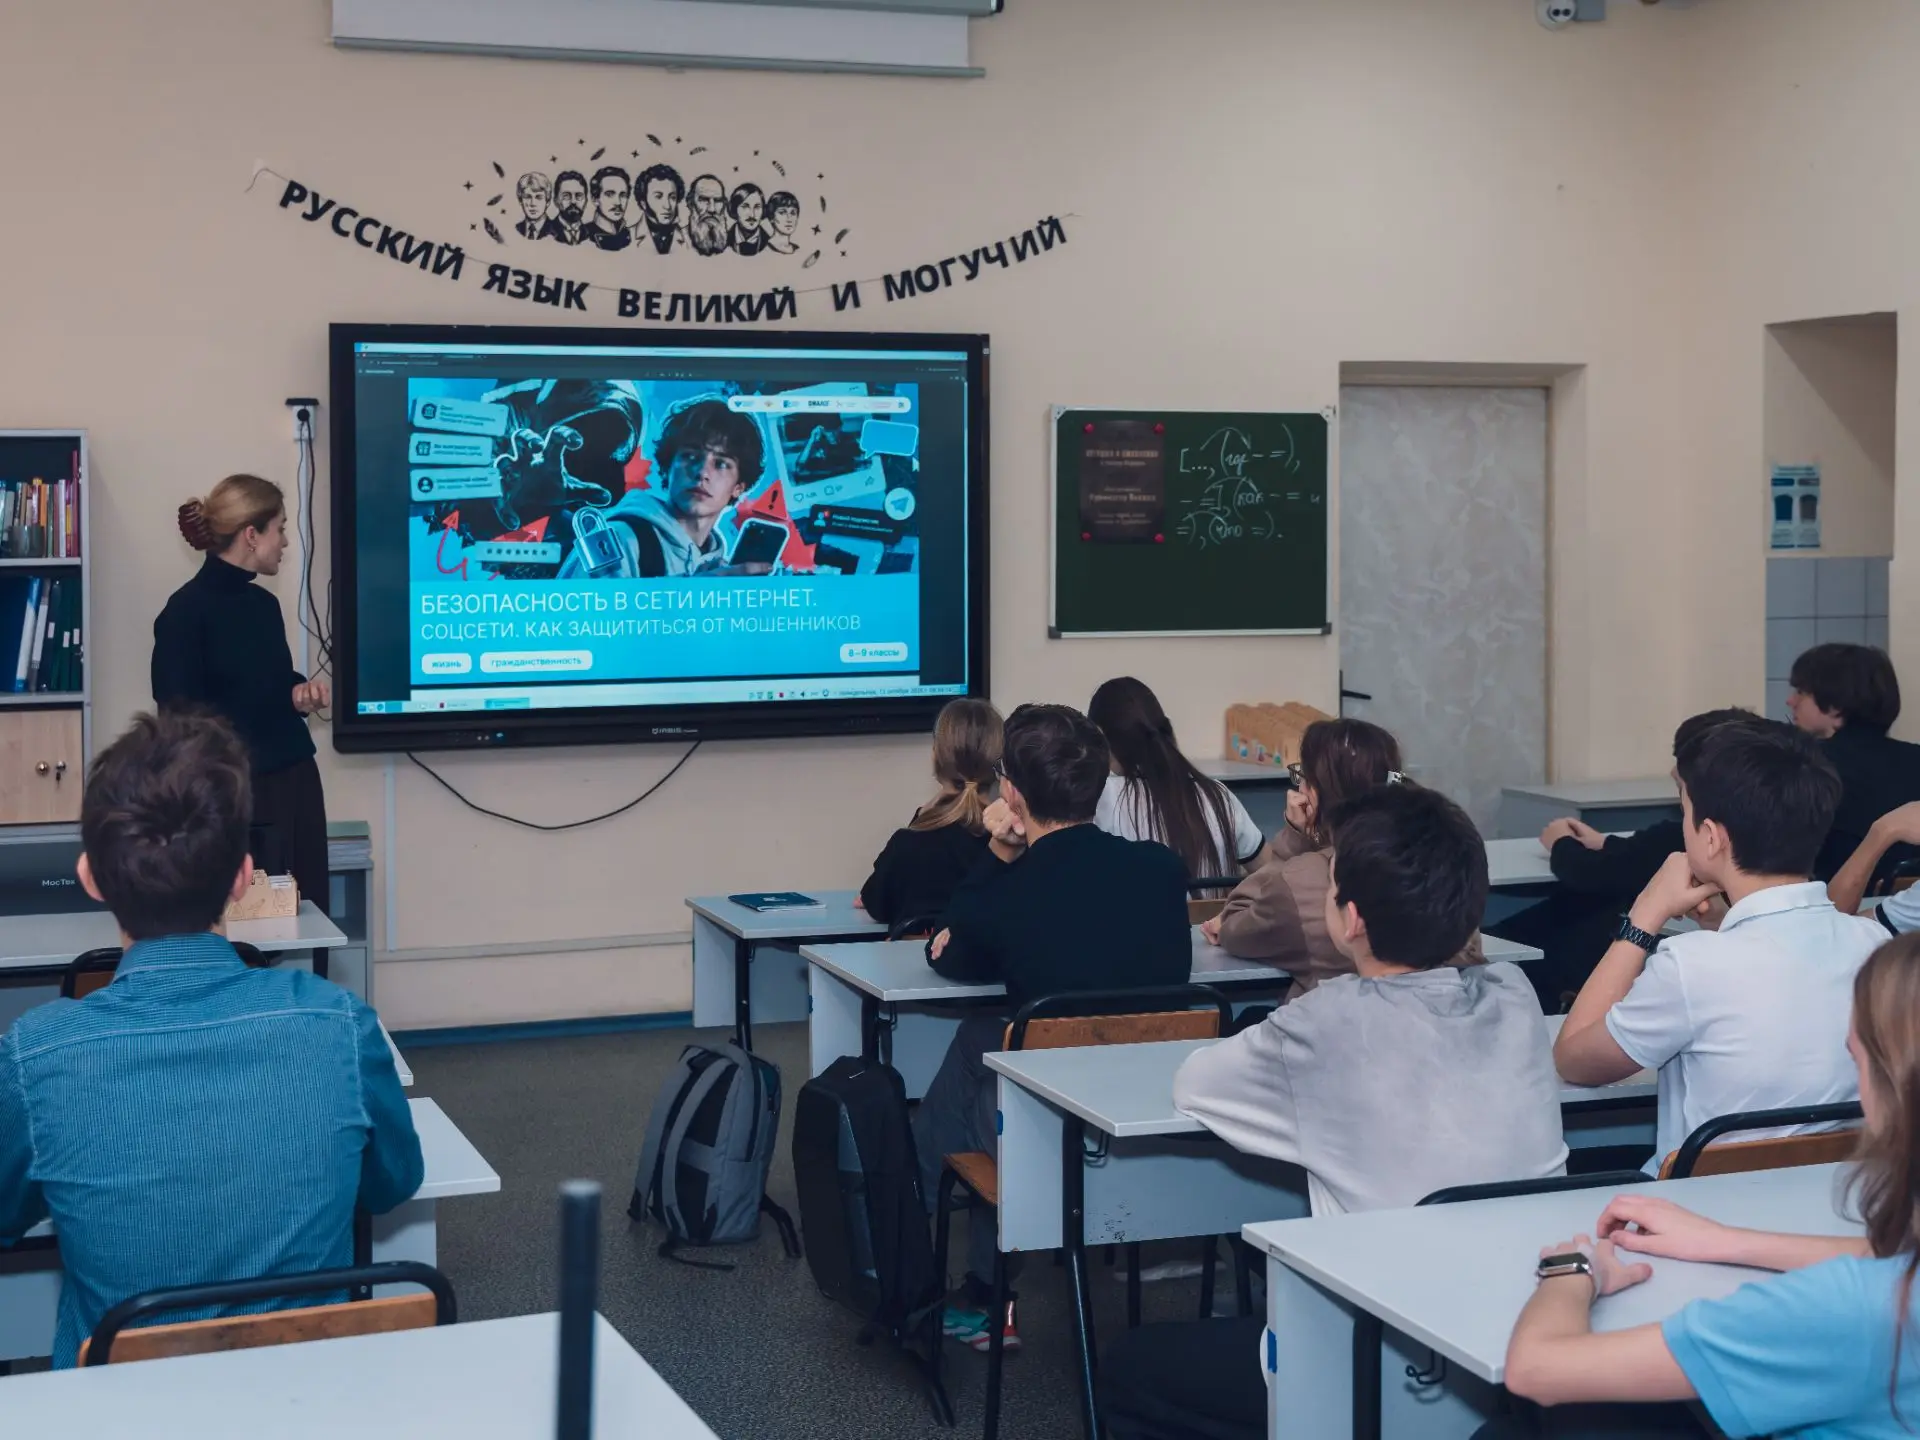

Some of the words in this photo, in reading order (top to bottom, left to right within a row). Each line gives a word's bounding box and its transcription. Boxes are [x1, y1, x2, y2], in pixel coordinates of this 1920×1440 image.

[279, 180, 464, 281] РУССКИЙ
[482, 263, 589, 311] ЯЗЫК
[617, 285, 798, 323] ВЕЛИКИЙ
[831, 281, 861, 312] И
[882, 214, 1068, 302] МОГУЧИЙ
[421, 591, 608, 615] БЕЗОПАСНОСТЬ
[614, 591, 628, 611] В
[634, 589, 693, 611] СЕТИ
[699, 588, 818, 610] ИНТЕРНЕТ.
[420, 621, 519, 642] СОЦСЕТИ.
[525, 621, 562, 638] КАК
[568, 618, 696, 639] ЗАЩИТИТЬСЯ
[702, 617, 725, 634] ОТ
[730, 614, 861, 634] МОШЕННИКОВ
[491, 656, 582, 669] гражданственность
[868, 648, 900, 658] классы
[431, 659, 462, 669] жизнь
